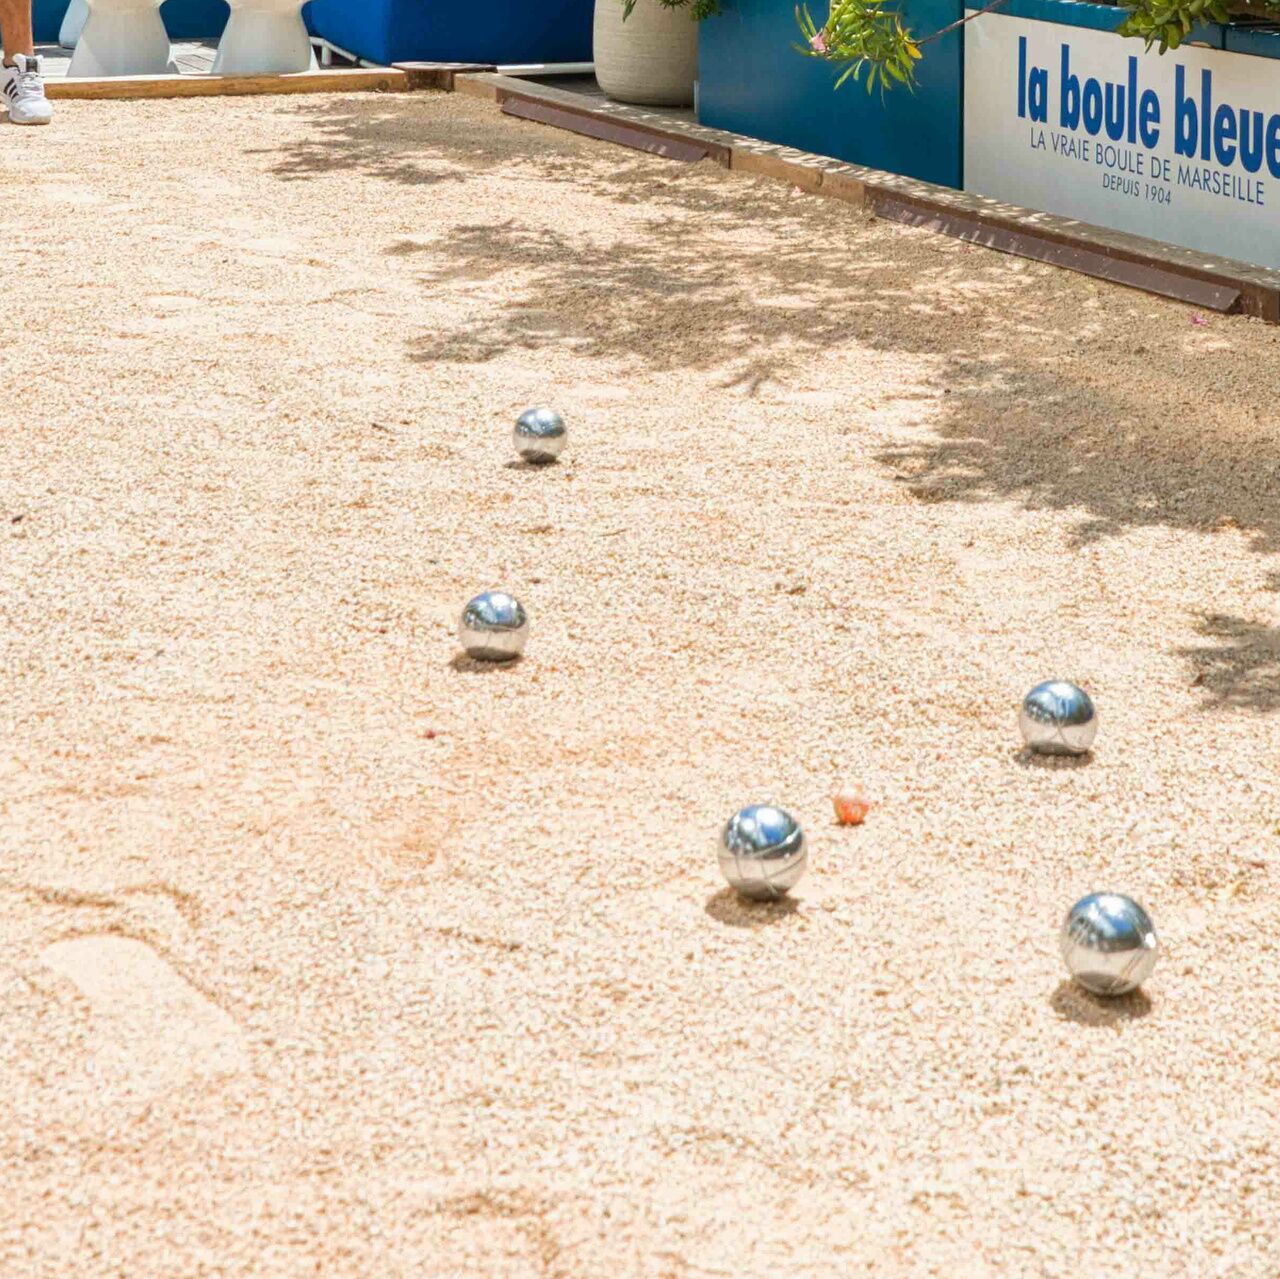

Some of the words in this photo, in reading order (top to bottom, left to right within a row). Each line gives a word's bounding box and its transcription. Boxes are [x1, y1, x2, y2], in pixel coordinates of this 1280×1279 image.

[1018, 36, 1046, 123] la
[1060, 44, 1160, 149] boule
[1031, 128, 1047, 150] LA
[1050, 133, 1090, 162] VRAIE
[1096, 145, 1144, 175] BOULE
[1151, 157, 1171, 181] DE
[1177, 165, 1265, 206] MARSEILLE
[1102, 173, 1140, 198] DEPUIS
[1145, 183, 1172, 206] 1904
